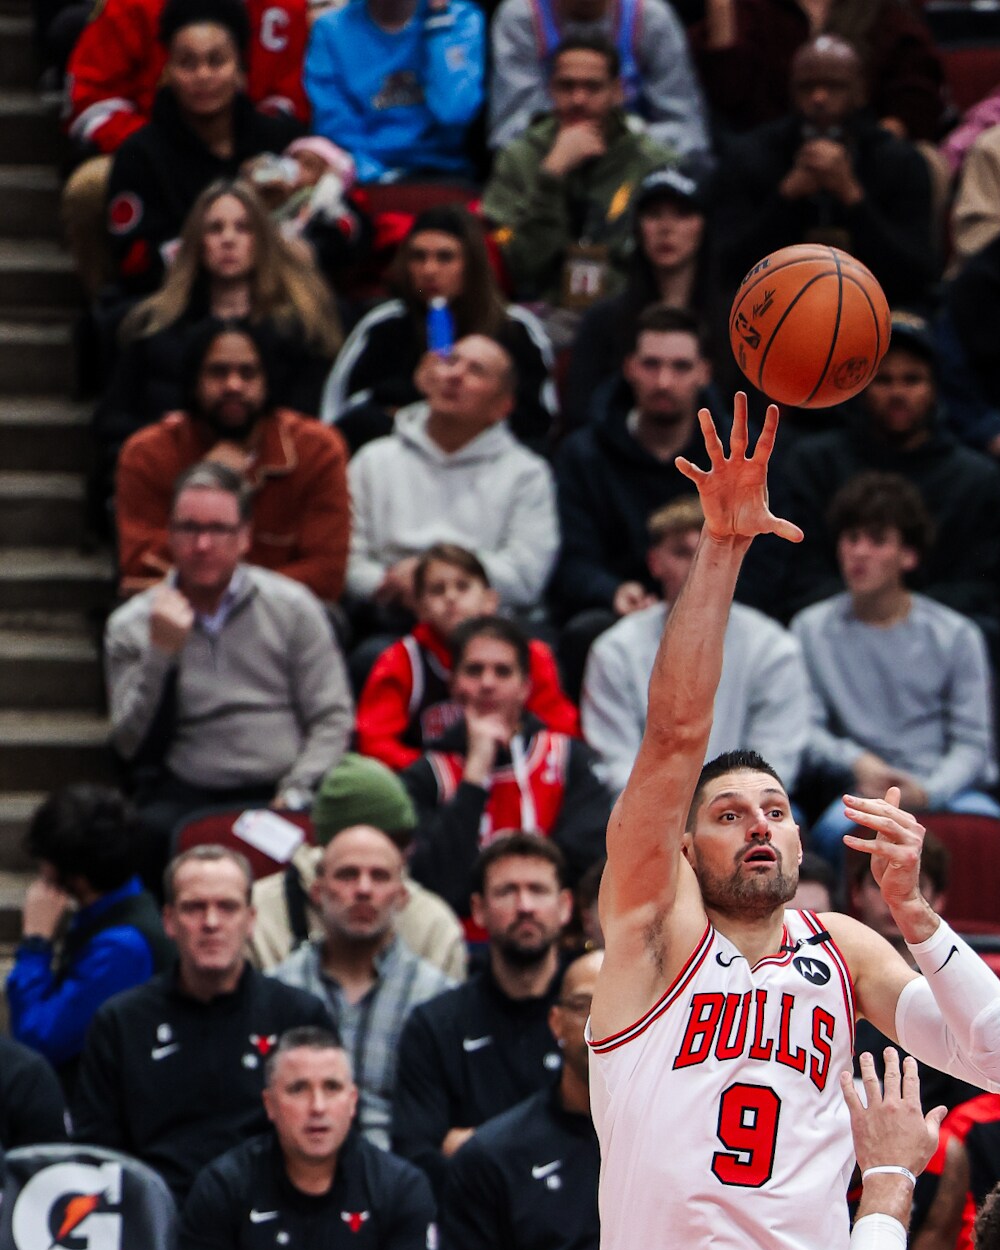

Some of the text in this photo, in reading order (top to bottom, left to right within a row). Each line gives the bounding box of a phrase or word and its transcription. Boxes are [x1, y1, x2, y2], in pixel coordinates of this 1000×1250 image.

[260, 7, 289, 51] C
[672, 988, 836, 1093] BULLS
[710, 1081, 782, 1188] 9
